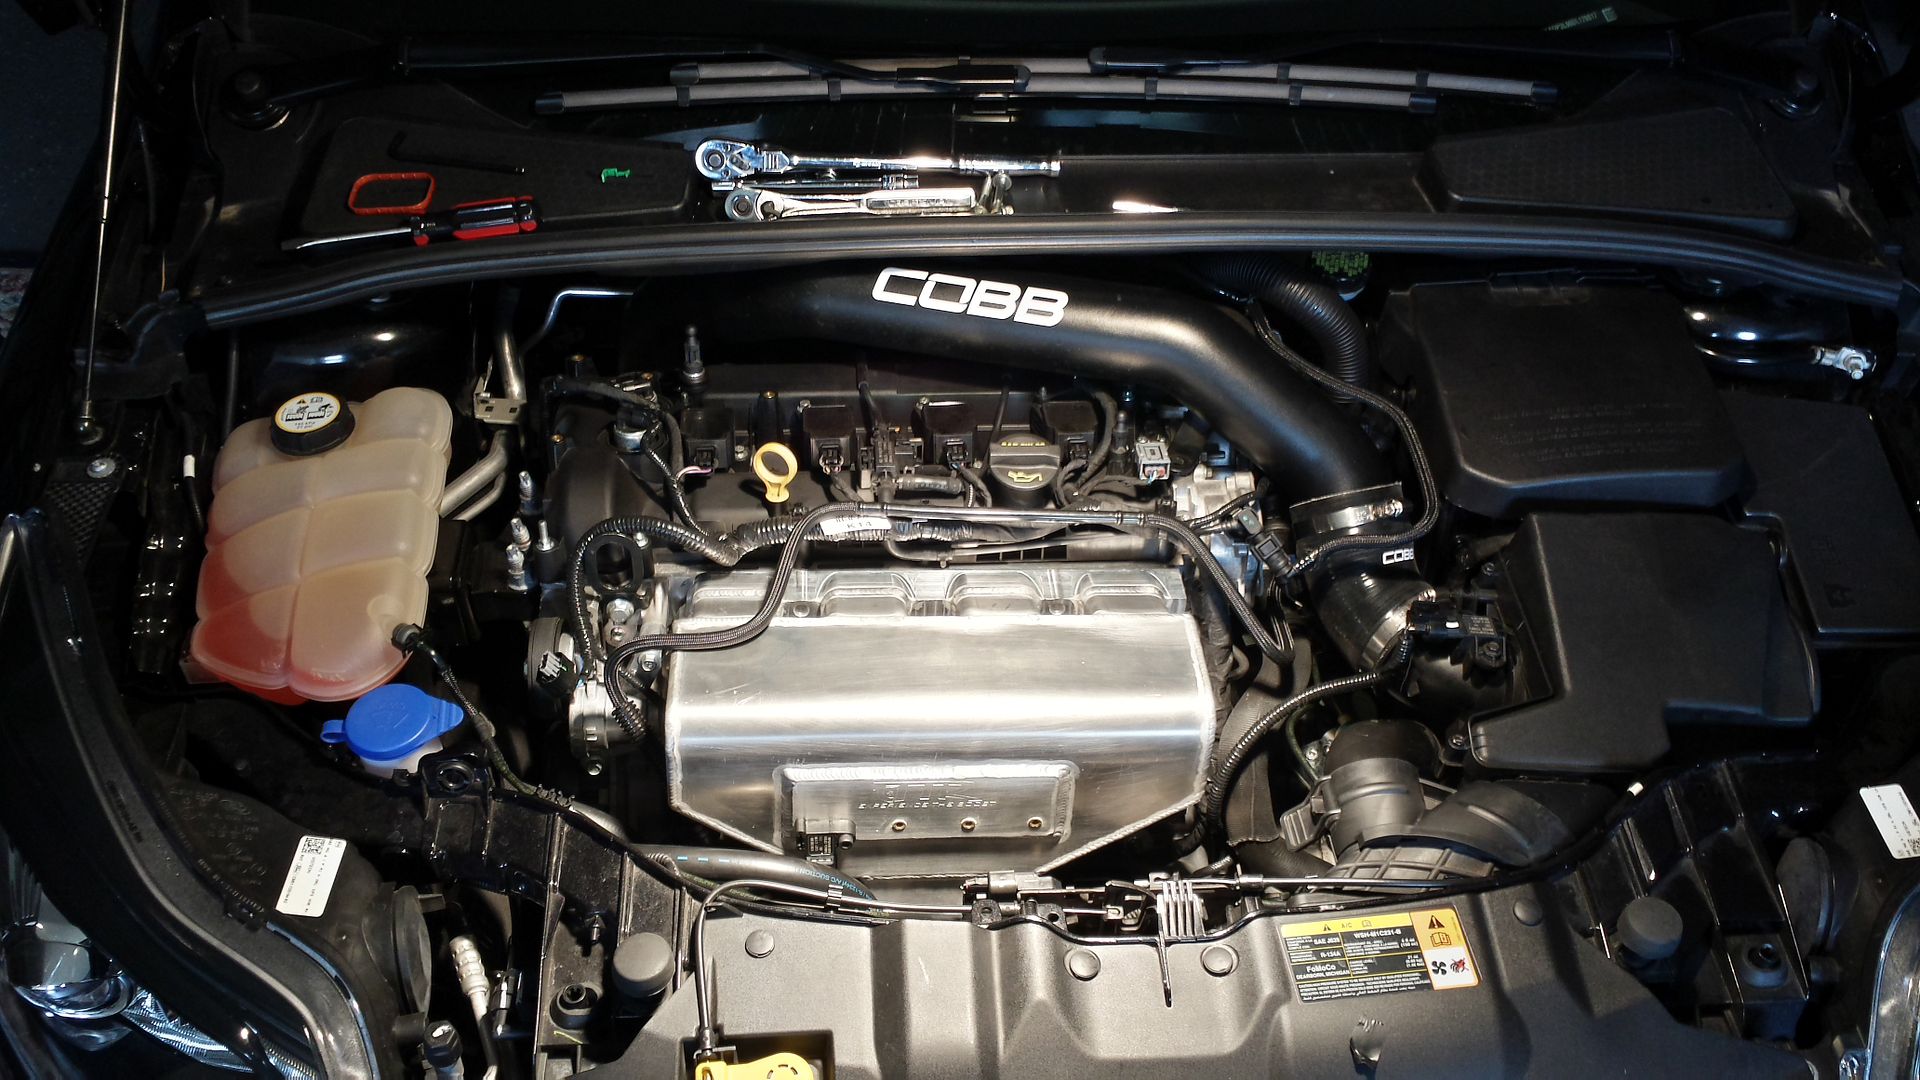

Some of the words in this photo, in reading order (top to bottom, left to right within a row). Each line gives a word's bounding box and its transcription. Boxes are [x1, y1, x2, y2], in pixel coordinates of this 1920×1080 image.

[871, 266, 1069, 327] COBB
[1382, 548, 1415, 565] COBB
[799, 867, 830, 881] SUCTION
[1306, 964, 1337, 973] FoMoCo
